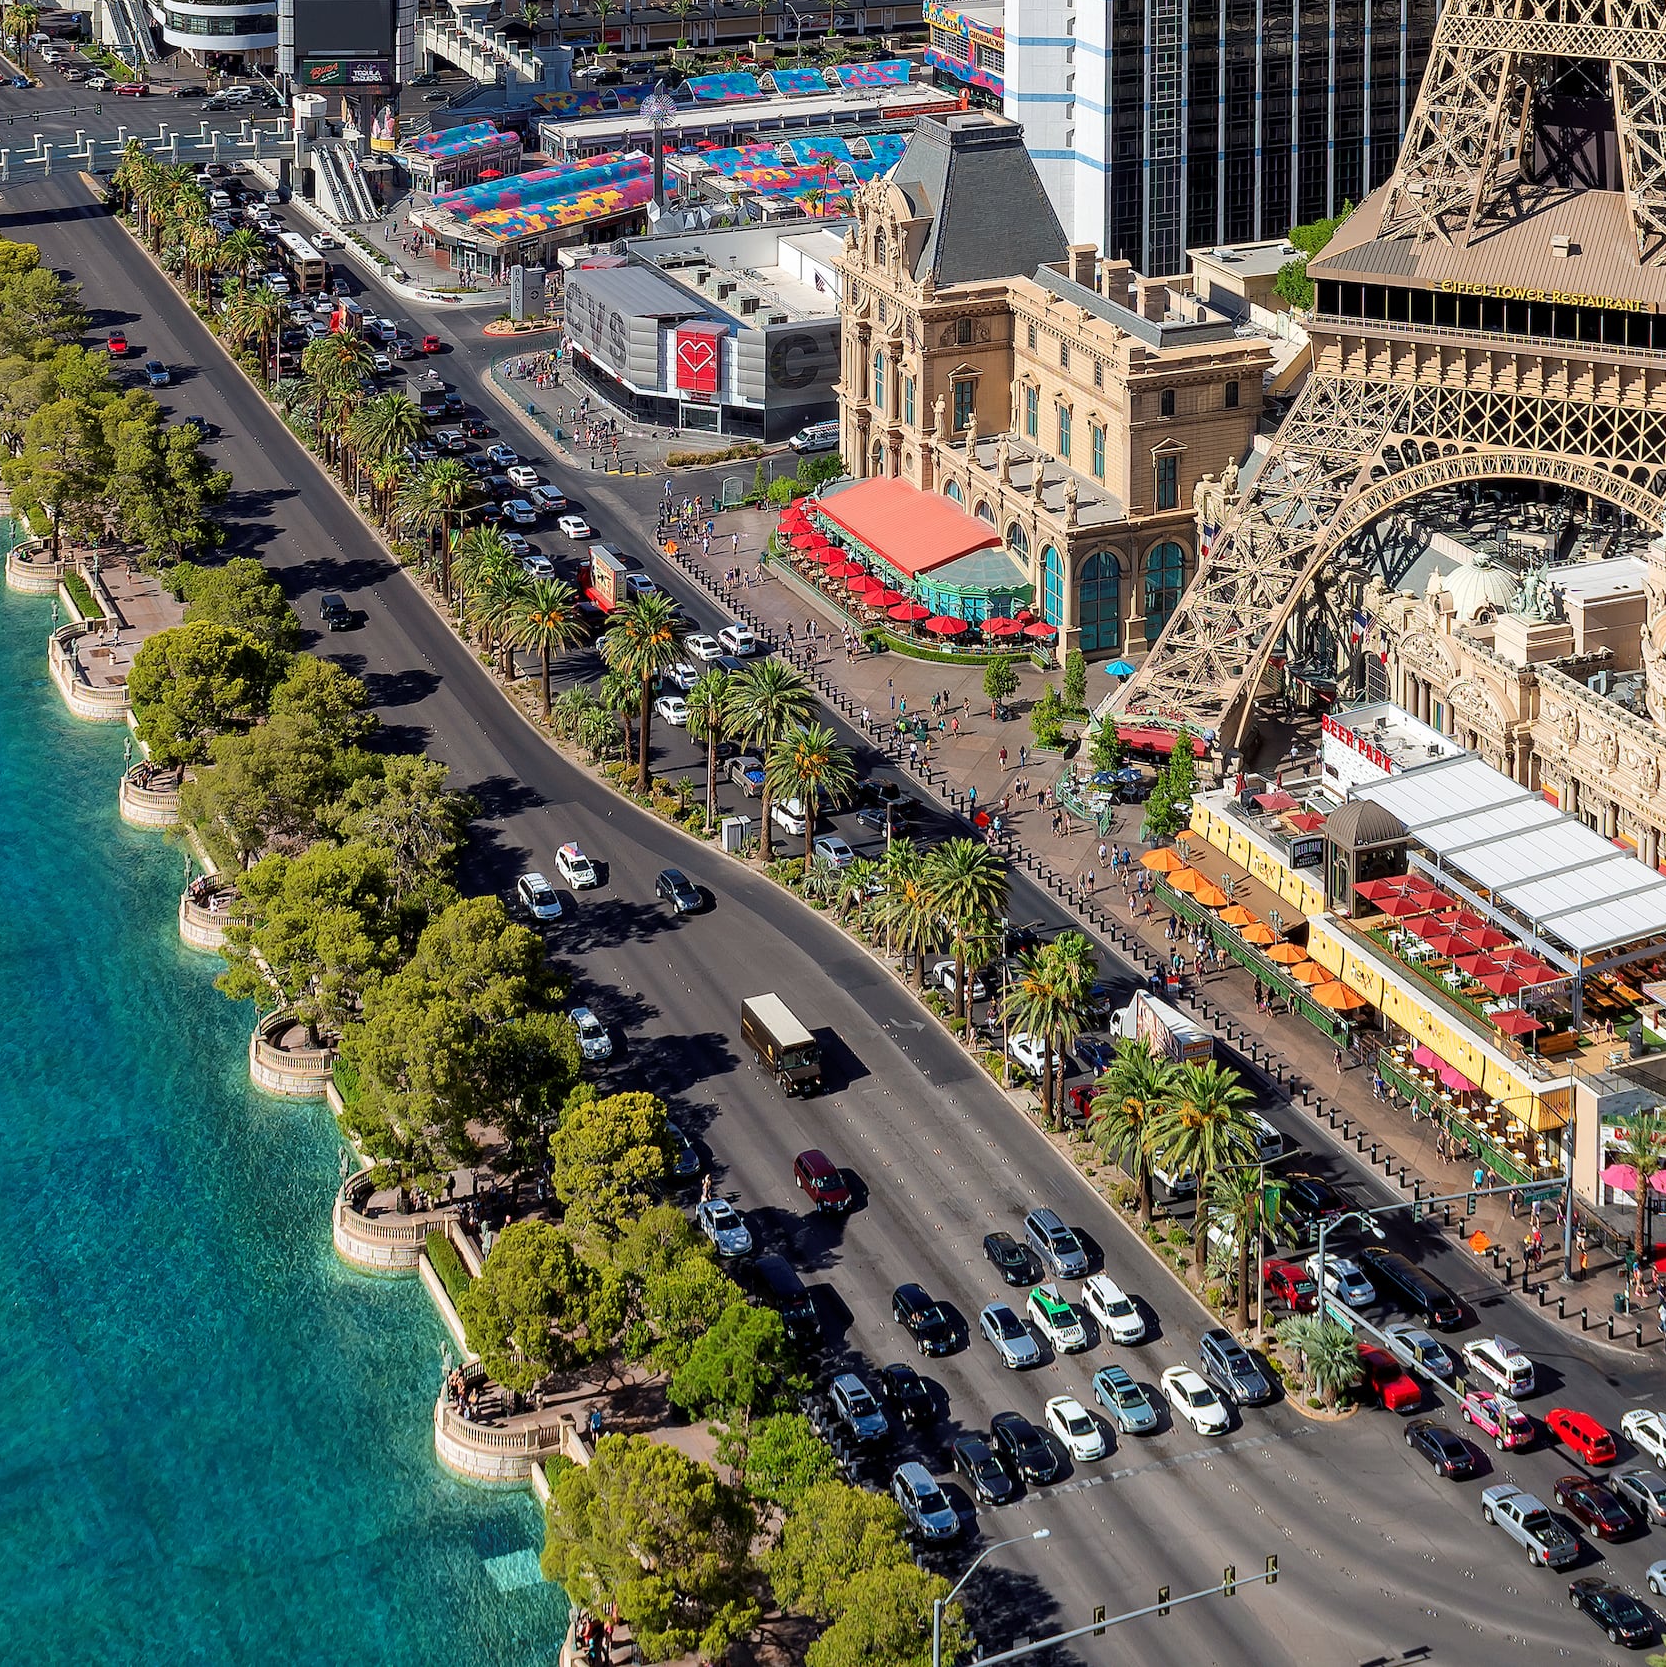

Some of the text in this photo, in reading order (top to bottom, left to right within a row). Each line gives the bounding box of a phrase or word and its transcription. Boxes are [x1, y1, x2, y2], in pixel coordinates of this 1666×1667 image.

[920, 11, 954, 31] STARBUCKS
[1441, 279, 1643, 312] EIFFEL TOWER RESTAURANT
[564, 282, 624, 370] CVS
[1322, 713, 1391, 774] BEER PARK
[1294, 839, 1321, 858] BEER PARK
